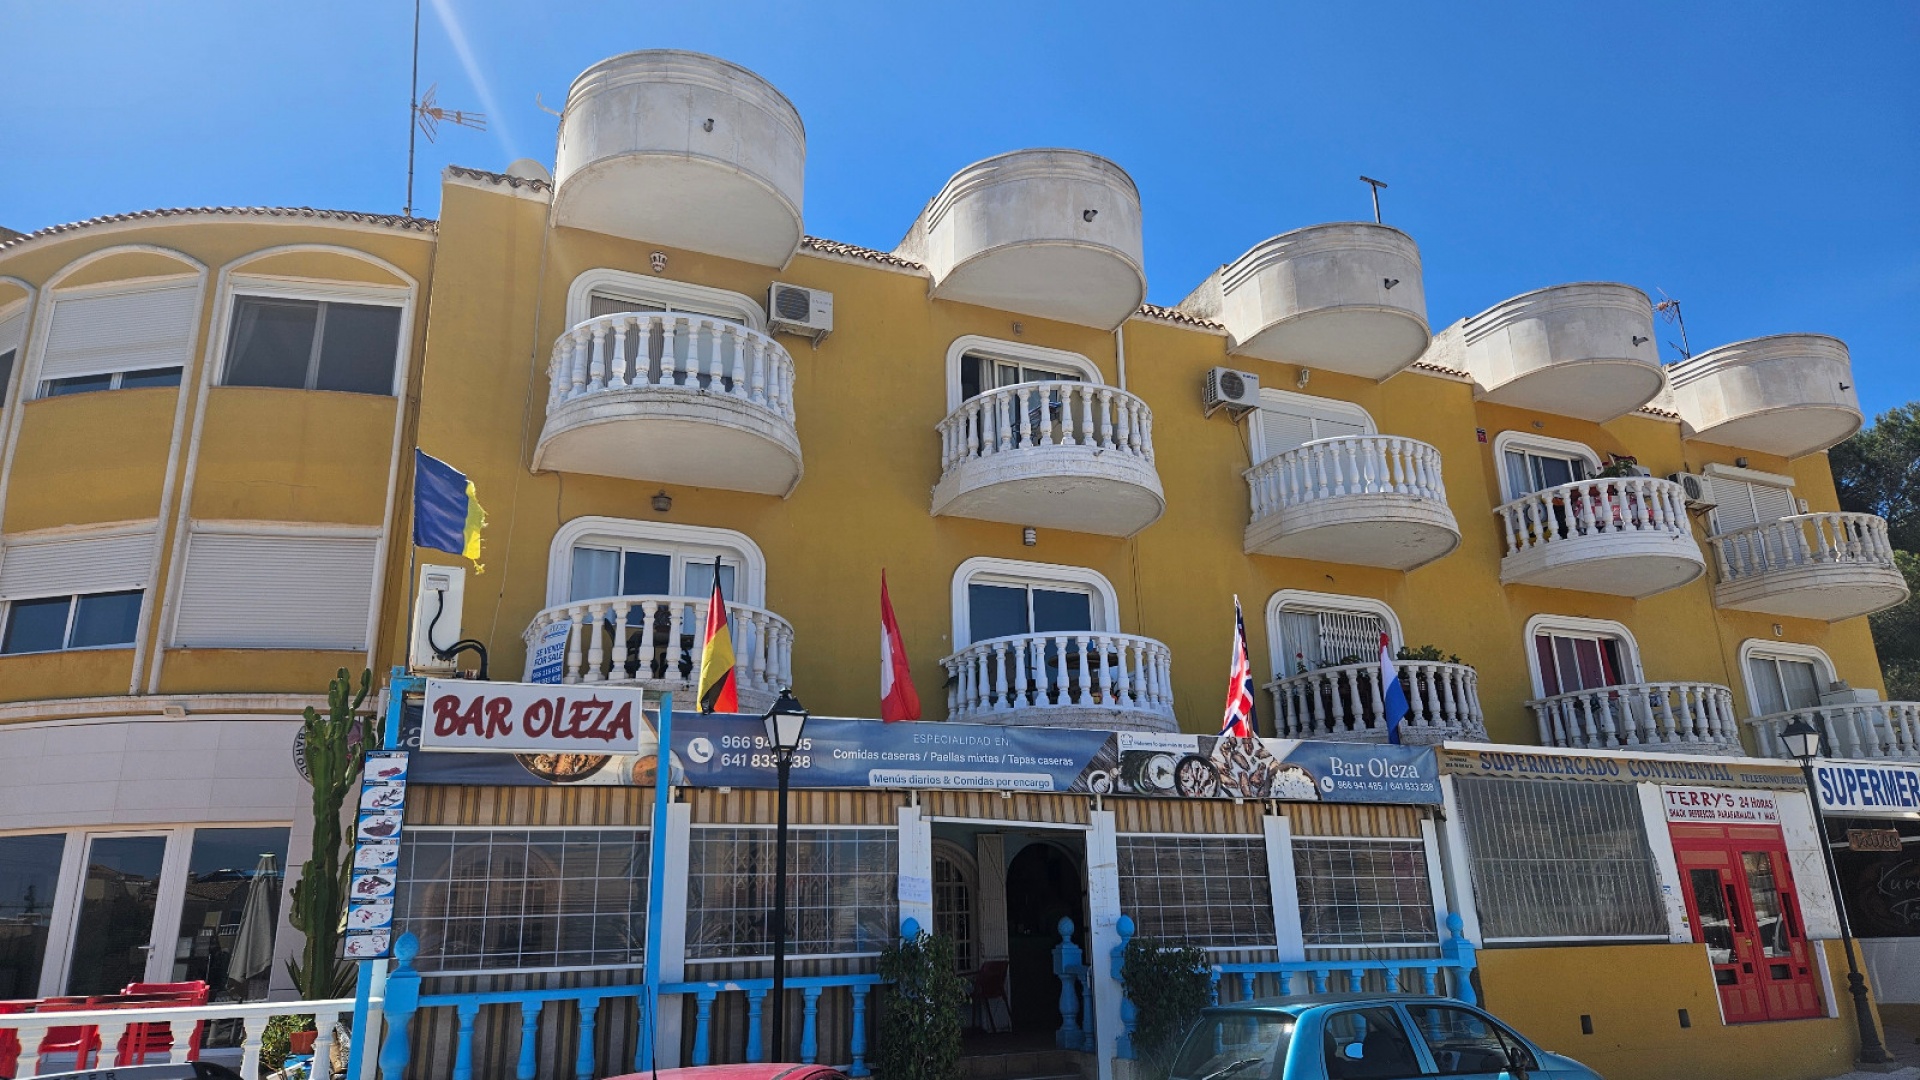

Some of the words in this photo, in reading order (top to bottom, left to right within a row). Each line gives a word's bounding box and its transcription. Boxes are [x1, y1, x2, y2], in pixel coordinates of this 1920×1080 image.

[534, 656, 547, 667] FOR
[547, 651, 564, 663] SALE
[433, 695, 513, 739] BAR
[523, 693, 633, 742] OLEZA
[721, 735, 750, 749] 966
[913, 734, 991, 746] ESPECIALIDAD
[721, 753, 747, 767] 641
[750, 754, 778, 768] 833
[833, 749, 879, 760] Comidas
[881, 752, 921, 762] caseras
[923, 751, 928, 761] /
[930, 751, 966, 763] Paellas
[967, 753, 999, 764] mixtas
[1001, 754, 1006, 764] /
[1008, 754, 1037, 766] Tapas
[1037, 757, 1074, 767] caseras
[1329, 756, 1364, 777] Bar
[1368, 758, 1420, 779] Oleza
[1479, 752, 1620, 777] SUPERMERCADO
[1628, 759, 1734, 782] CONTINENTAL
[1740, 773, 1779, 785] TELEFONO
[873, 773, 907, 784] Menús
[909, 774, 941, 785] diarios
[943, 776, 951, 785] &
[953, 776, 995, 786] Comidas
[996, 779, 1010, 788] por
[1013, 779, 1050, 788] encargo
[1353, 781, 1367, 790] 941
[1368, 781, 1383, 791] 485
[1404, 782, 1419, 792] 833
[1420, 783, 1435, 792] 238
[1818, 767, 1920, 807] SUPERMER
[1666, 790, 1735, 808] TERRY'S
[1739, 796, 1751, 808] 24
[1751, 797, 1774, 810] HORAS
